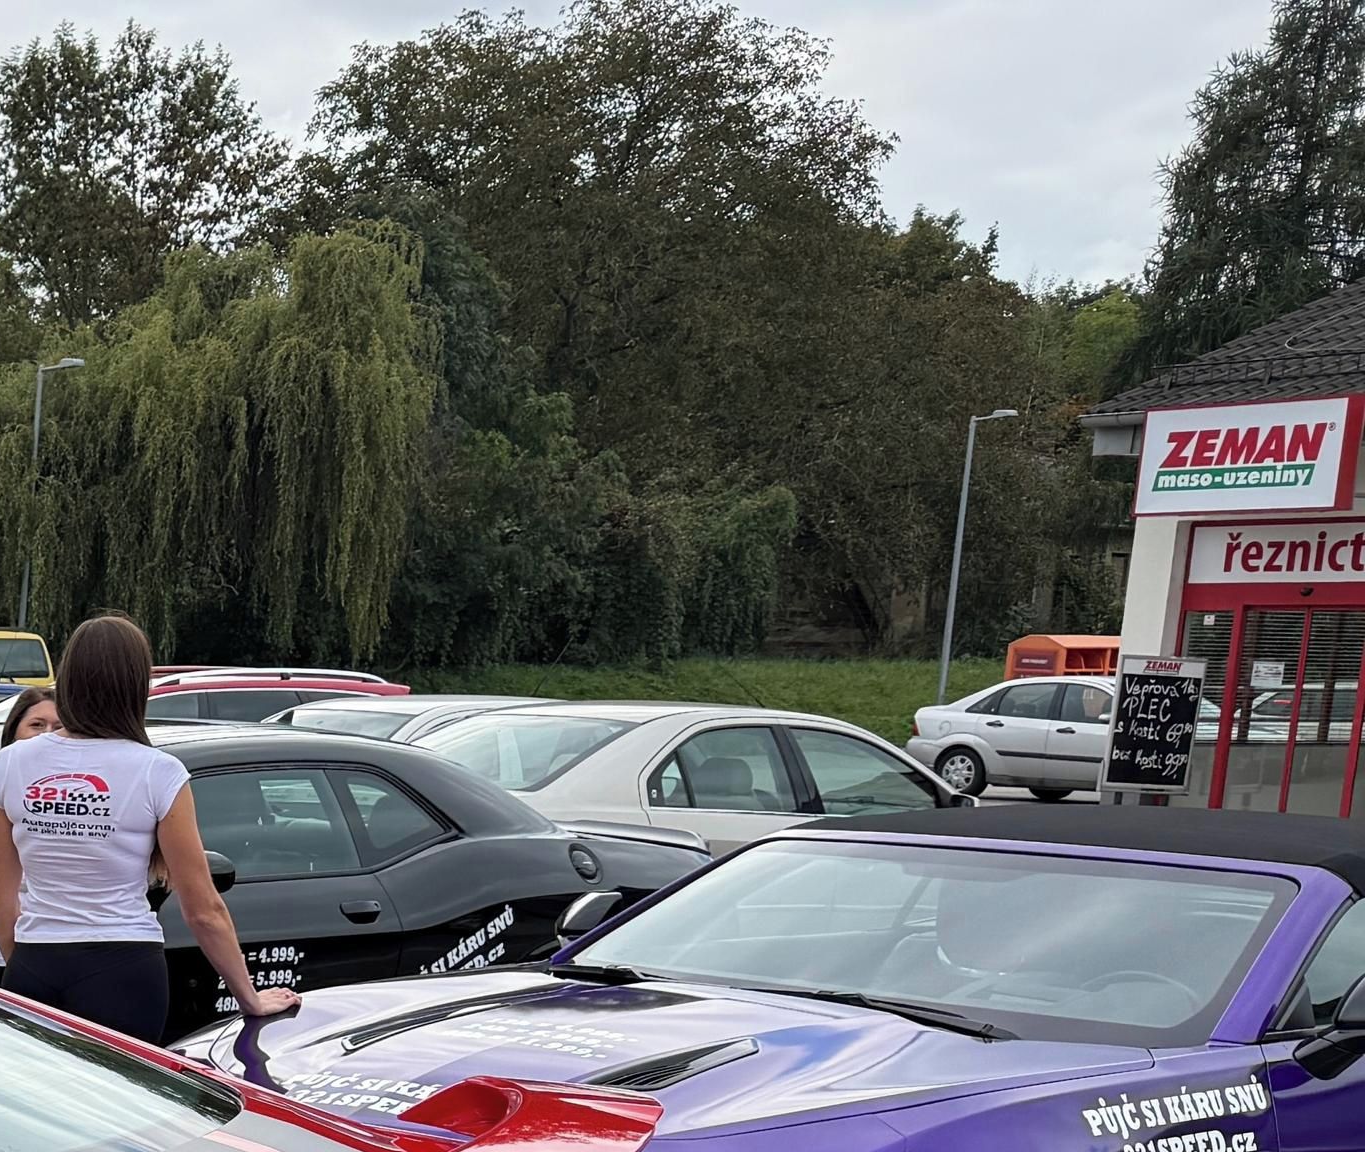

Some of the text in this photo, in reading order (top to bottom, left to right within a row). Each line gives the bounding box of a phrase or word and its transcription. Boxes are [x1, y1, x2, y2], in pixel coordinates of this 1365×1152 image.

[1159, 422, 1328, 469] ZEMAN
[1157, 465, 1311, 488] maso-uzeniny
[1145, 660, 1183, 671] ZEMAN
[1122, 696, 1171, 722] PLEC
[25, 786, 67, 801] 321
[446, 937, 486, 969] KÁRU
[487, 904, 514, 940] SNŮ
[259, 946, 305, 965] 4.999,-
[256, 969, 302, 987] 5.999,-
[1082, 1074, 1268, 1139] PŮJČ SI KÁRU SNŮ
